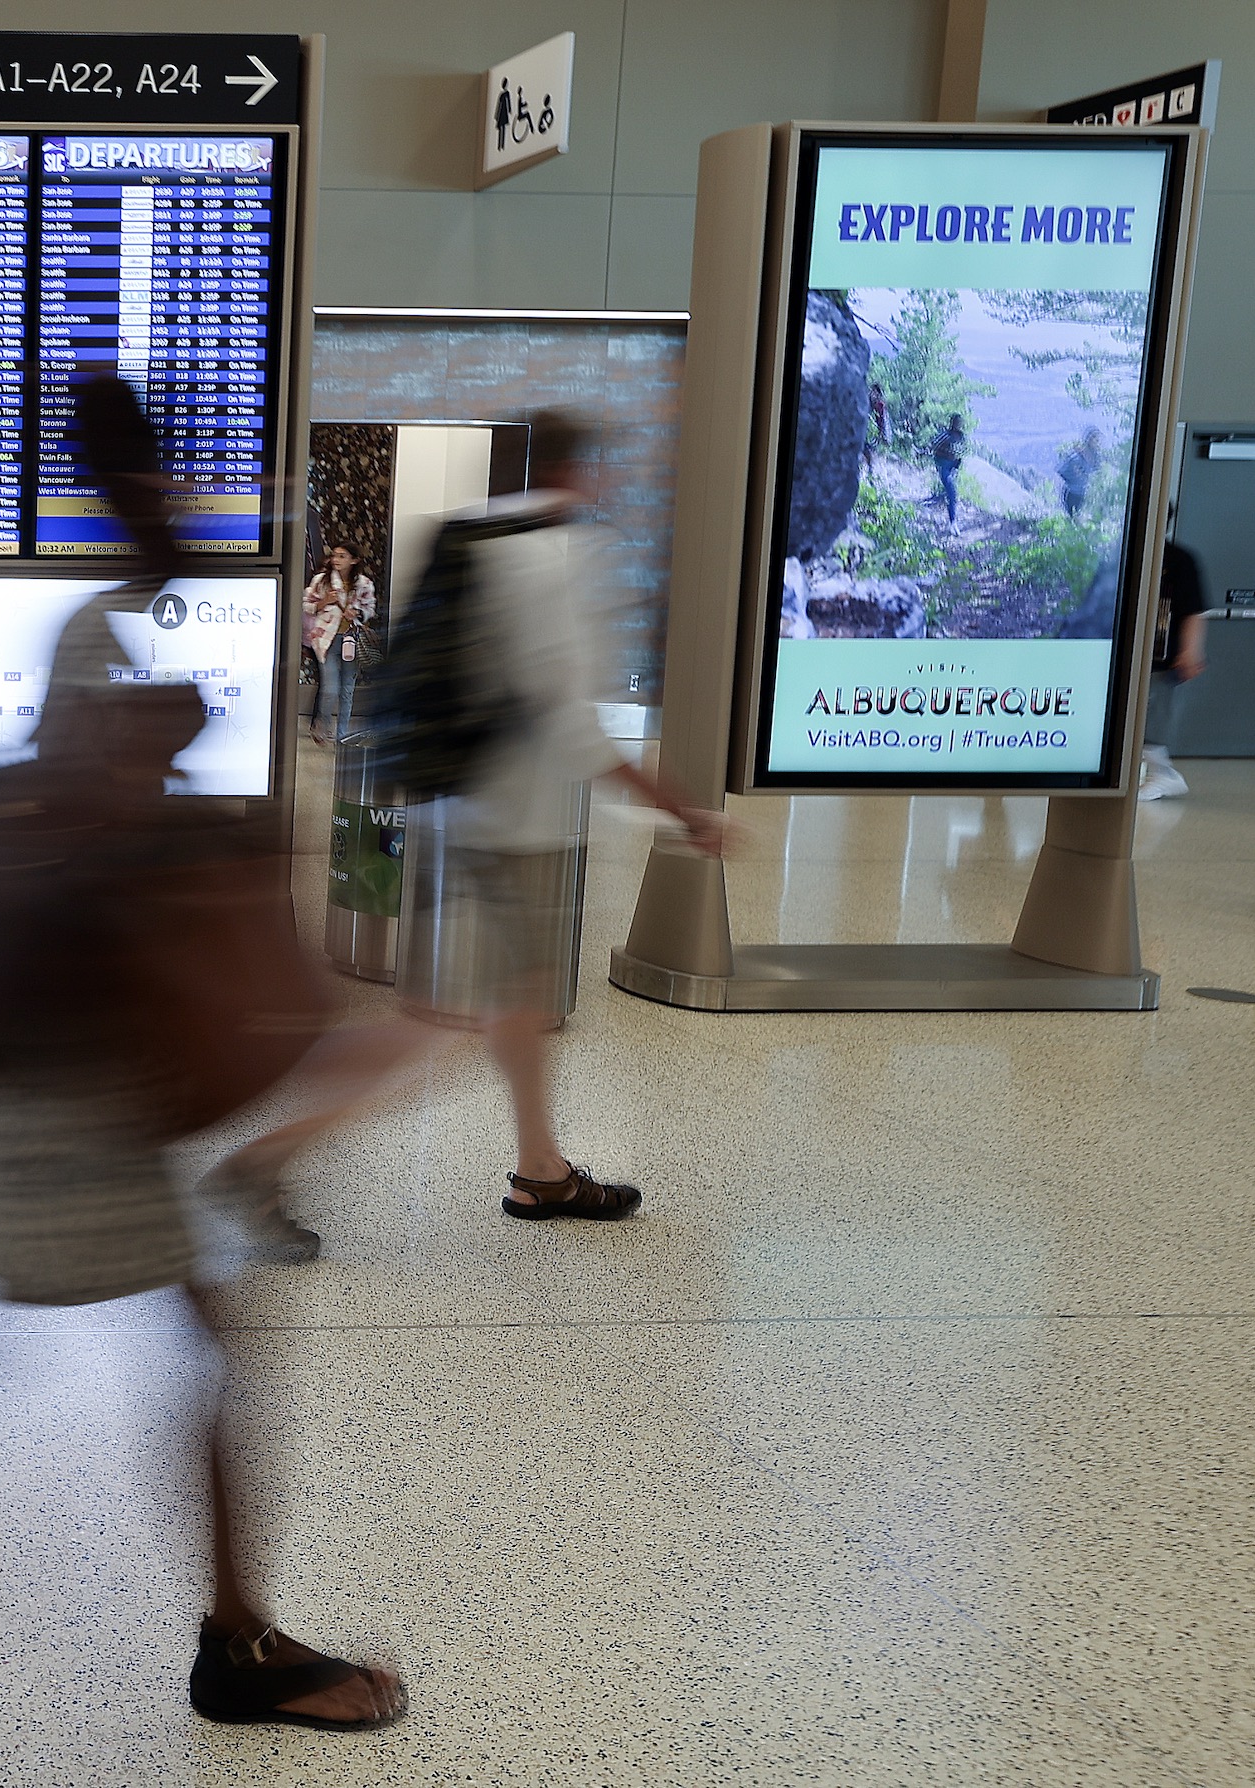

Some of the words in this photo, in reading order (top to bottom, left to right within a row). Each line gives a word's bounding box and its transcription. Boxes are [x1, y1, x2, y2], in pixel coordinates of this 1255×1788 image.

[136, 64, 202, 94] A24
[69, 143, 251, 169] DEPARTURES
[44, 154, 66, 172] SLC
[838, 204, 1014, 243] EXPLORE
[1021, 206, 1135, 244] MORE
[40, 362, 50, 370] St.
[51, 362, 76, 370] George
[40, 385, 50, 393] St.
[52, 385, 69, 393] Louis
[40, 396, 53, 404] Sun
[55, 396, 75, 406] Valley
[40, 431, 63, 439] Tucson
[39, 465, 75, 473] Vancouver
[84, 507, 100, 515] Please
[38, 545, 60, 553] 10:32
[62, 545, 75, 553] AM
[85, 545, 118, 553] Welcome
[227, 543, 252, 552] Airport
[197, 601, 262, 623] Gates
[806, 687, 1073, 716] ALBUQUERQUE
[807, 729, 943, 751] VisitABQ.org
[962, 730, 1067, 748] #TrueABQ
